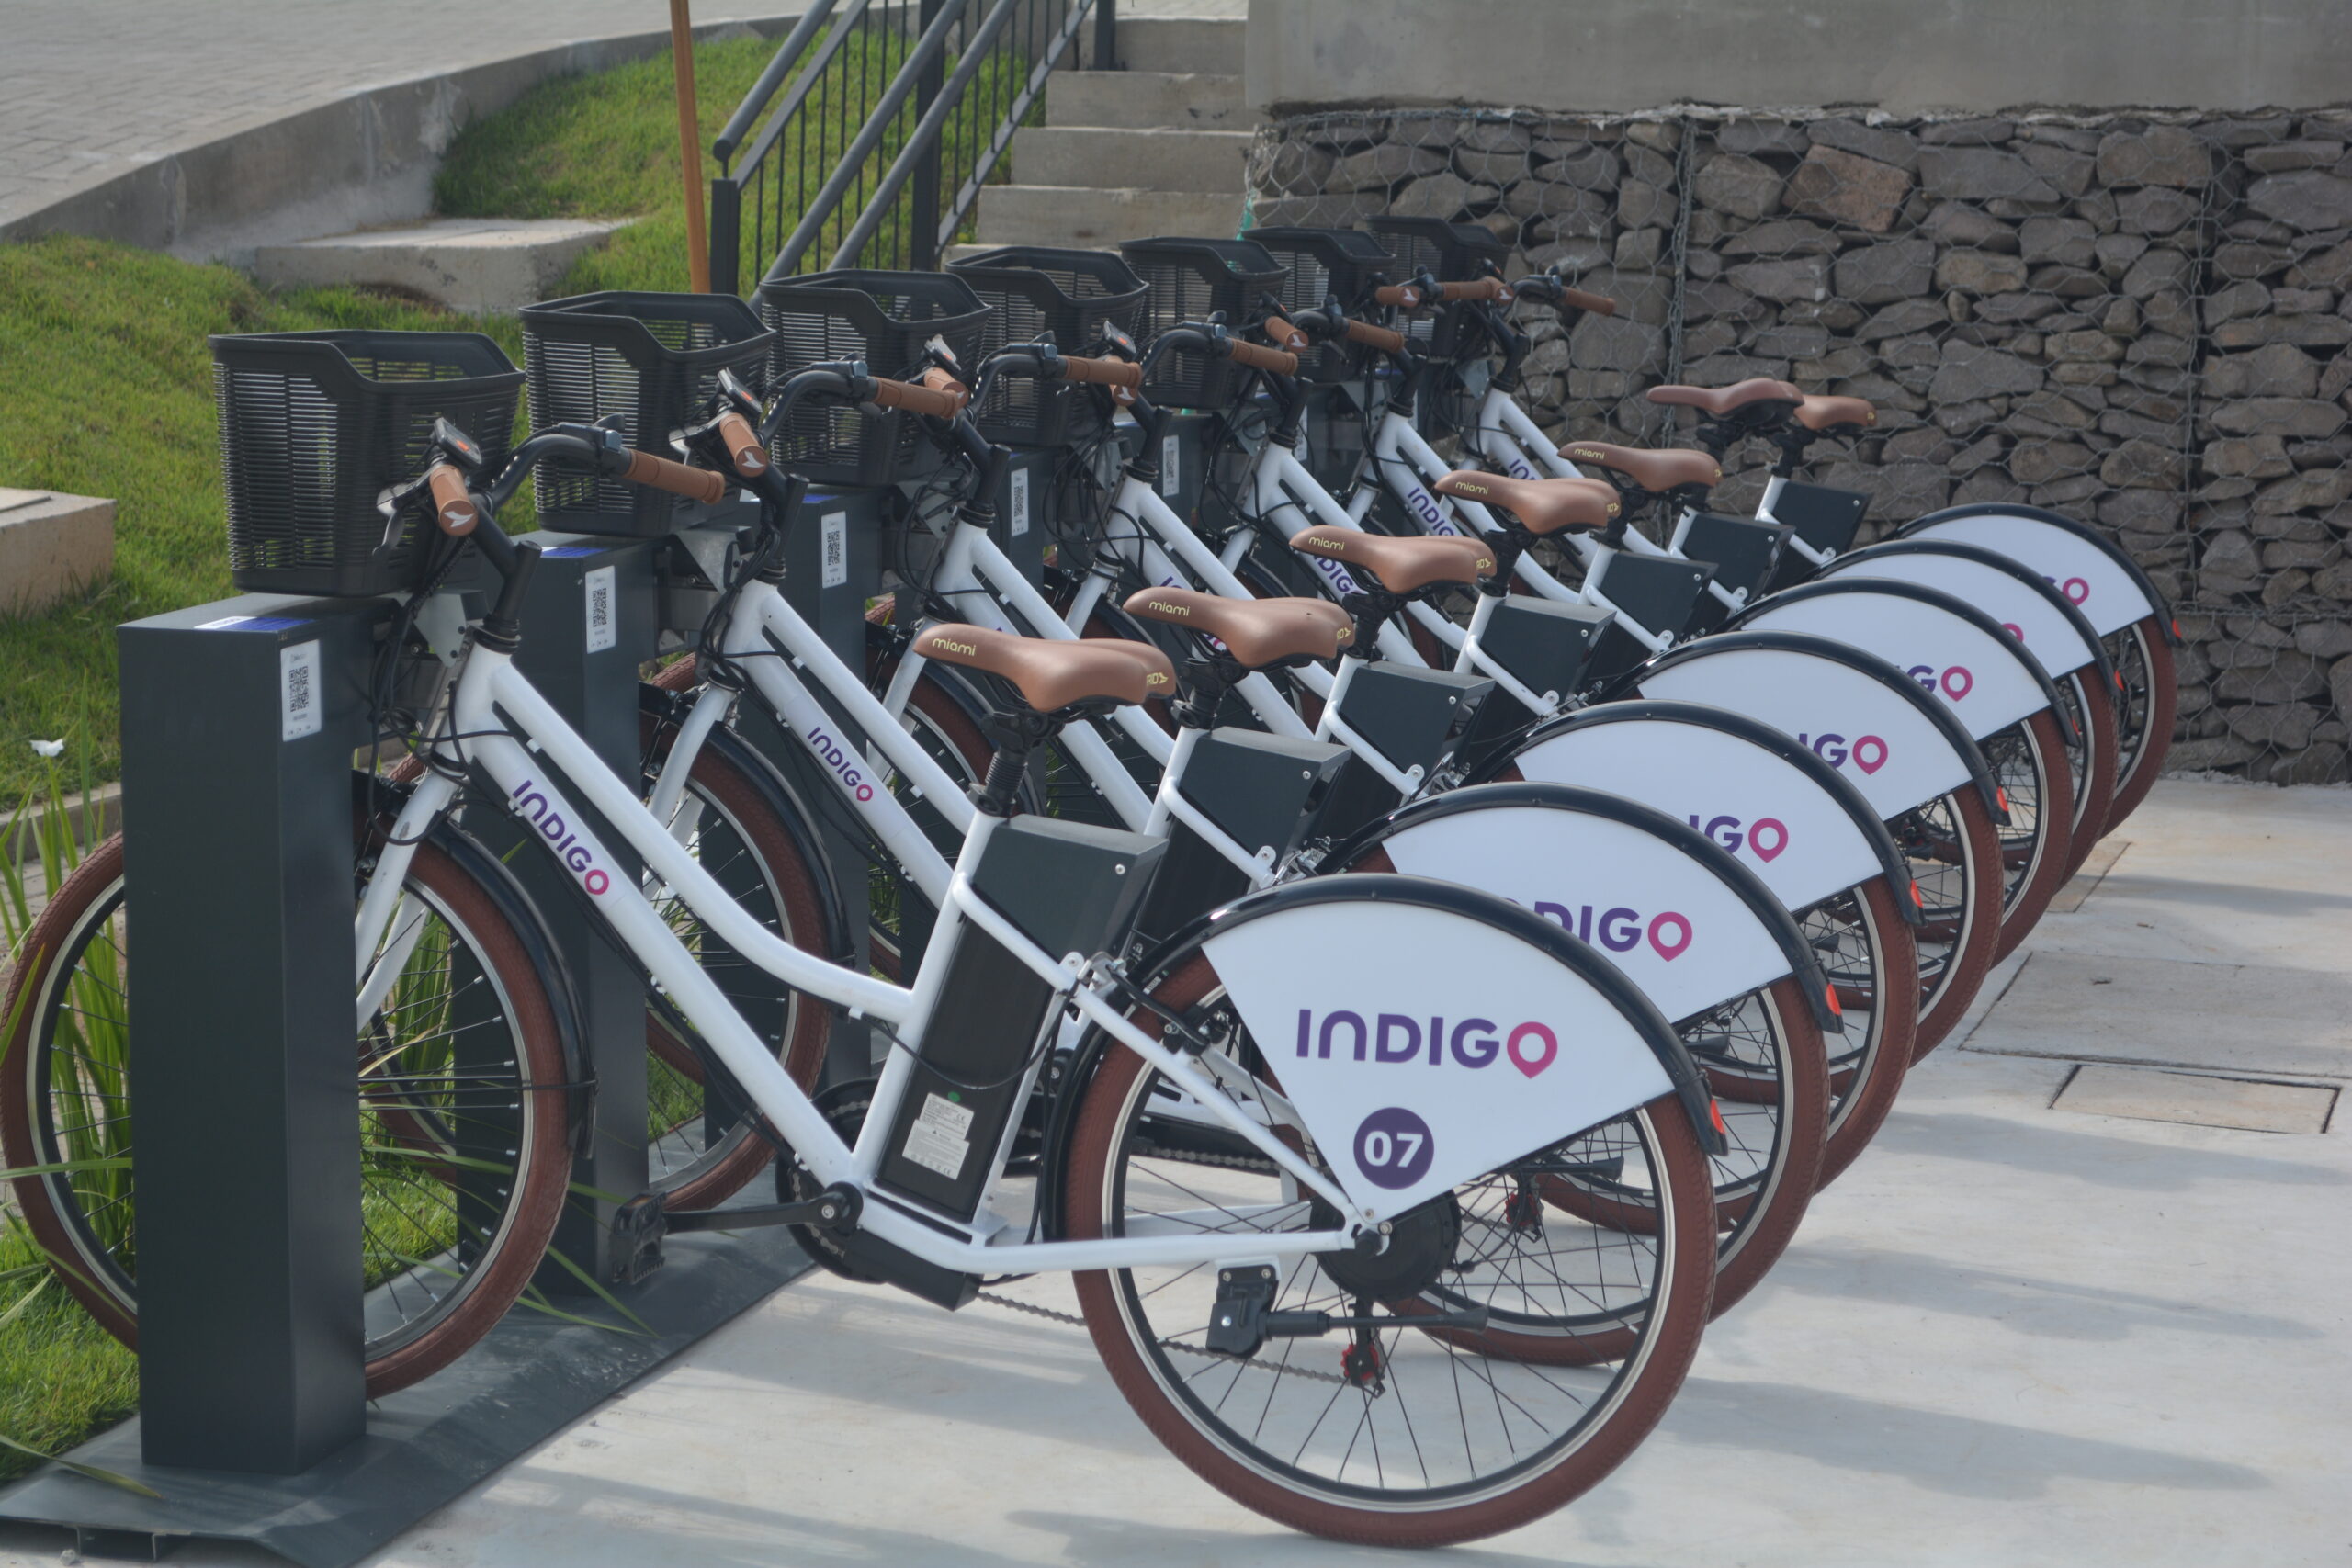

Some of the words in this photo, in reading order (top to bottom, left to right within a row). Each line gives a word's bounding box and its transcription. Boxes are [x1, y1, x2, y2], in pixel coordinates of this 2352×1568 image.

[1574, 447, 1605, 460] miami
[1455, 481, 1488, 496] miami
[1308, 536, 1345, 551] miami
[1313, 555, 1354, 592] DIG
[1148, 601, 1191, 617] miami
[932, 637, 977, 657] miami
[1893, 665, 1973, 702] GO
[807, 727, 874, 802] INDIGO
[513, 779, 610, 896] INDIGO
[1505, 897, 1692, 963] DIGO
[1296, 1009, 1558, 1079] INDIGO
[1364, 1130, 1424, 1168] 07
